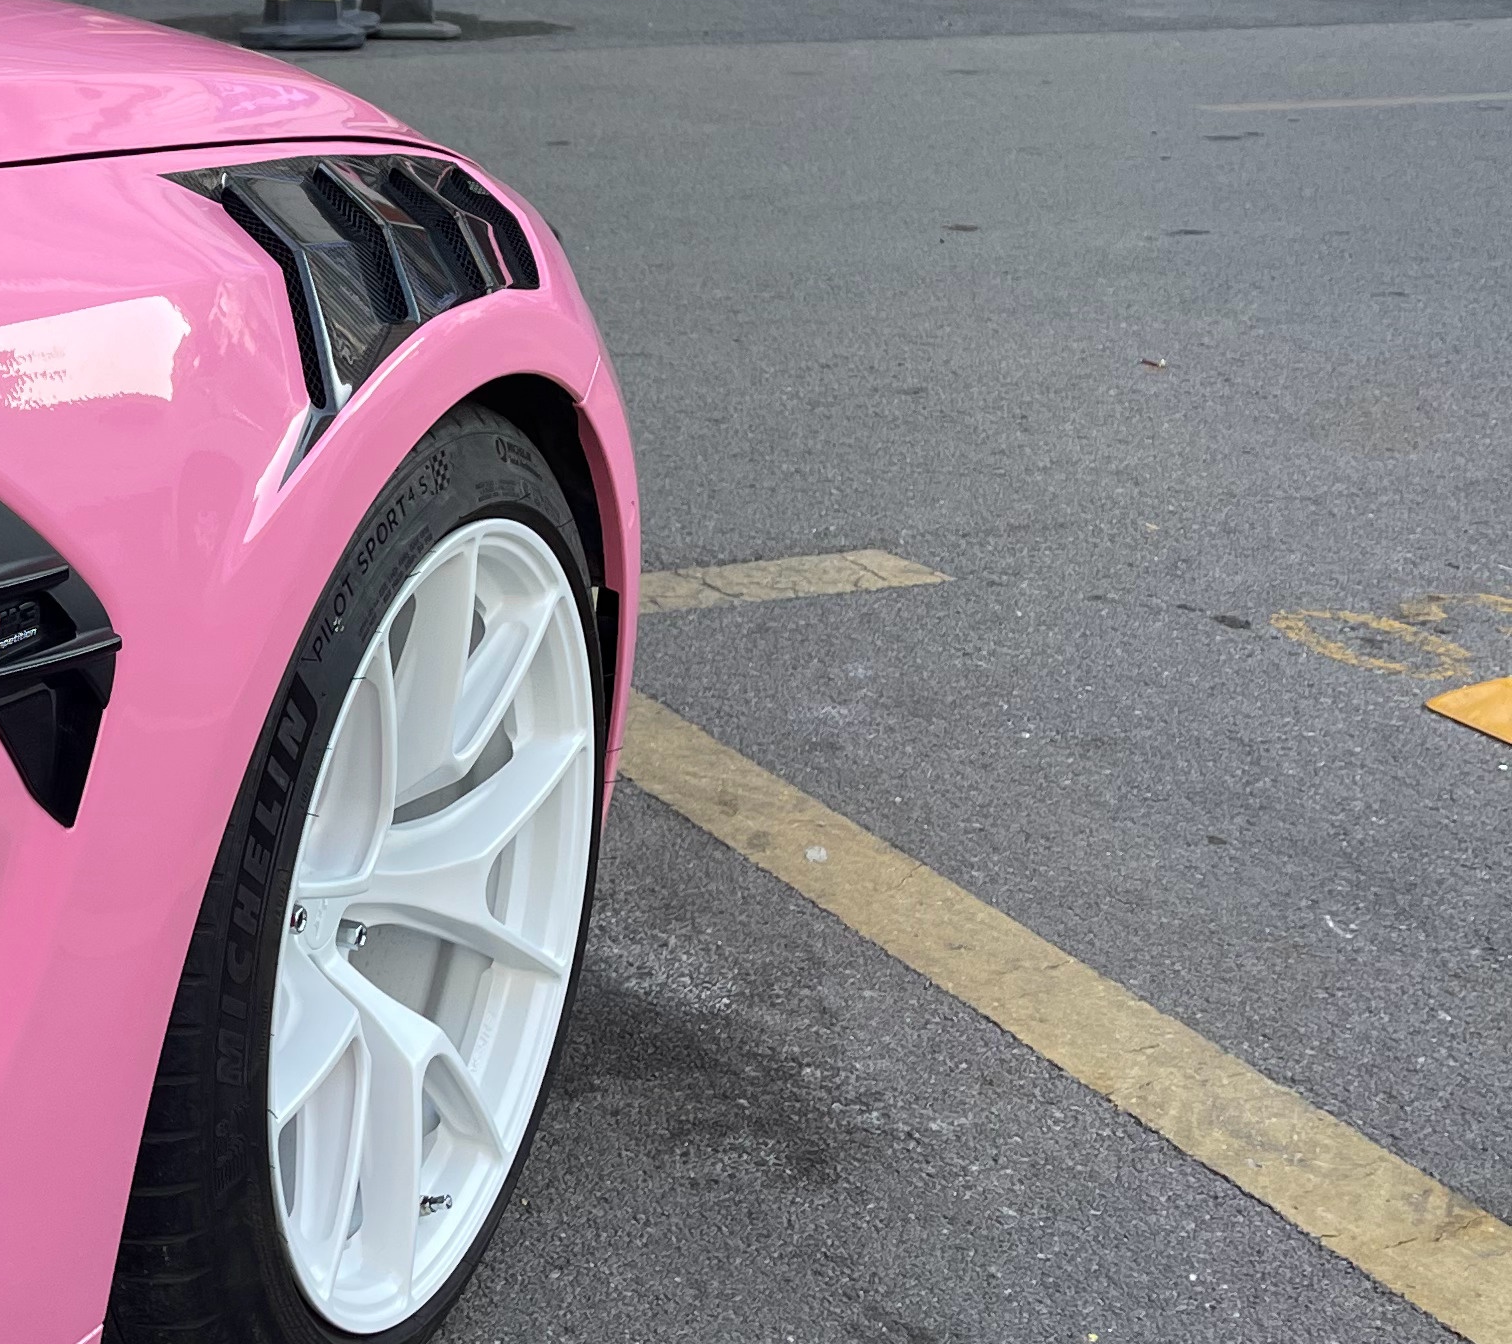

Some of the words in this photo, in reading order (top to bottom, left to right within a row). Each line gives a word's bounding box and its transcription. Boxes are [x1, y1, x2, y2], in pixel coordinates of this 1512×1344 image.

[309, 573, 357, 663] PILOT
[357, 494, 408, 575] SPORT
[216, 696, 309, 1087] MICHELIN
